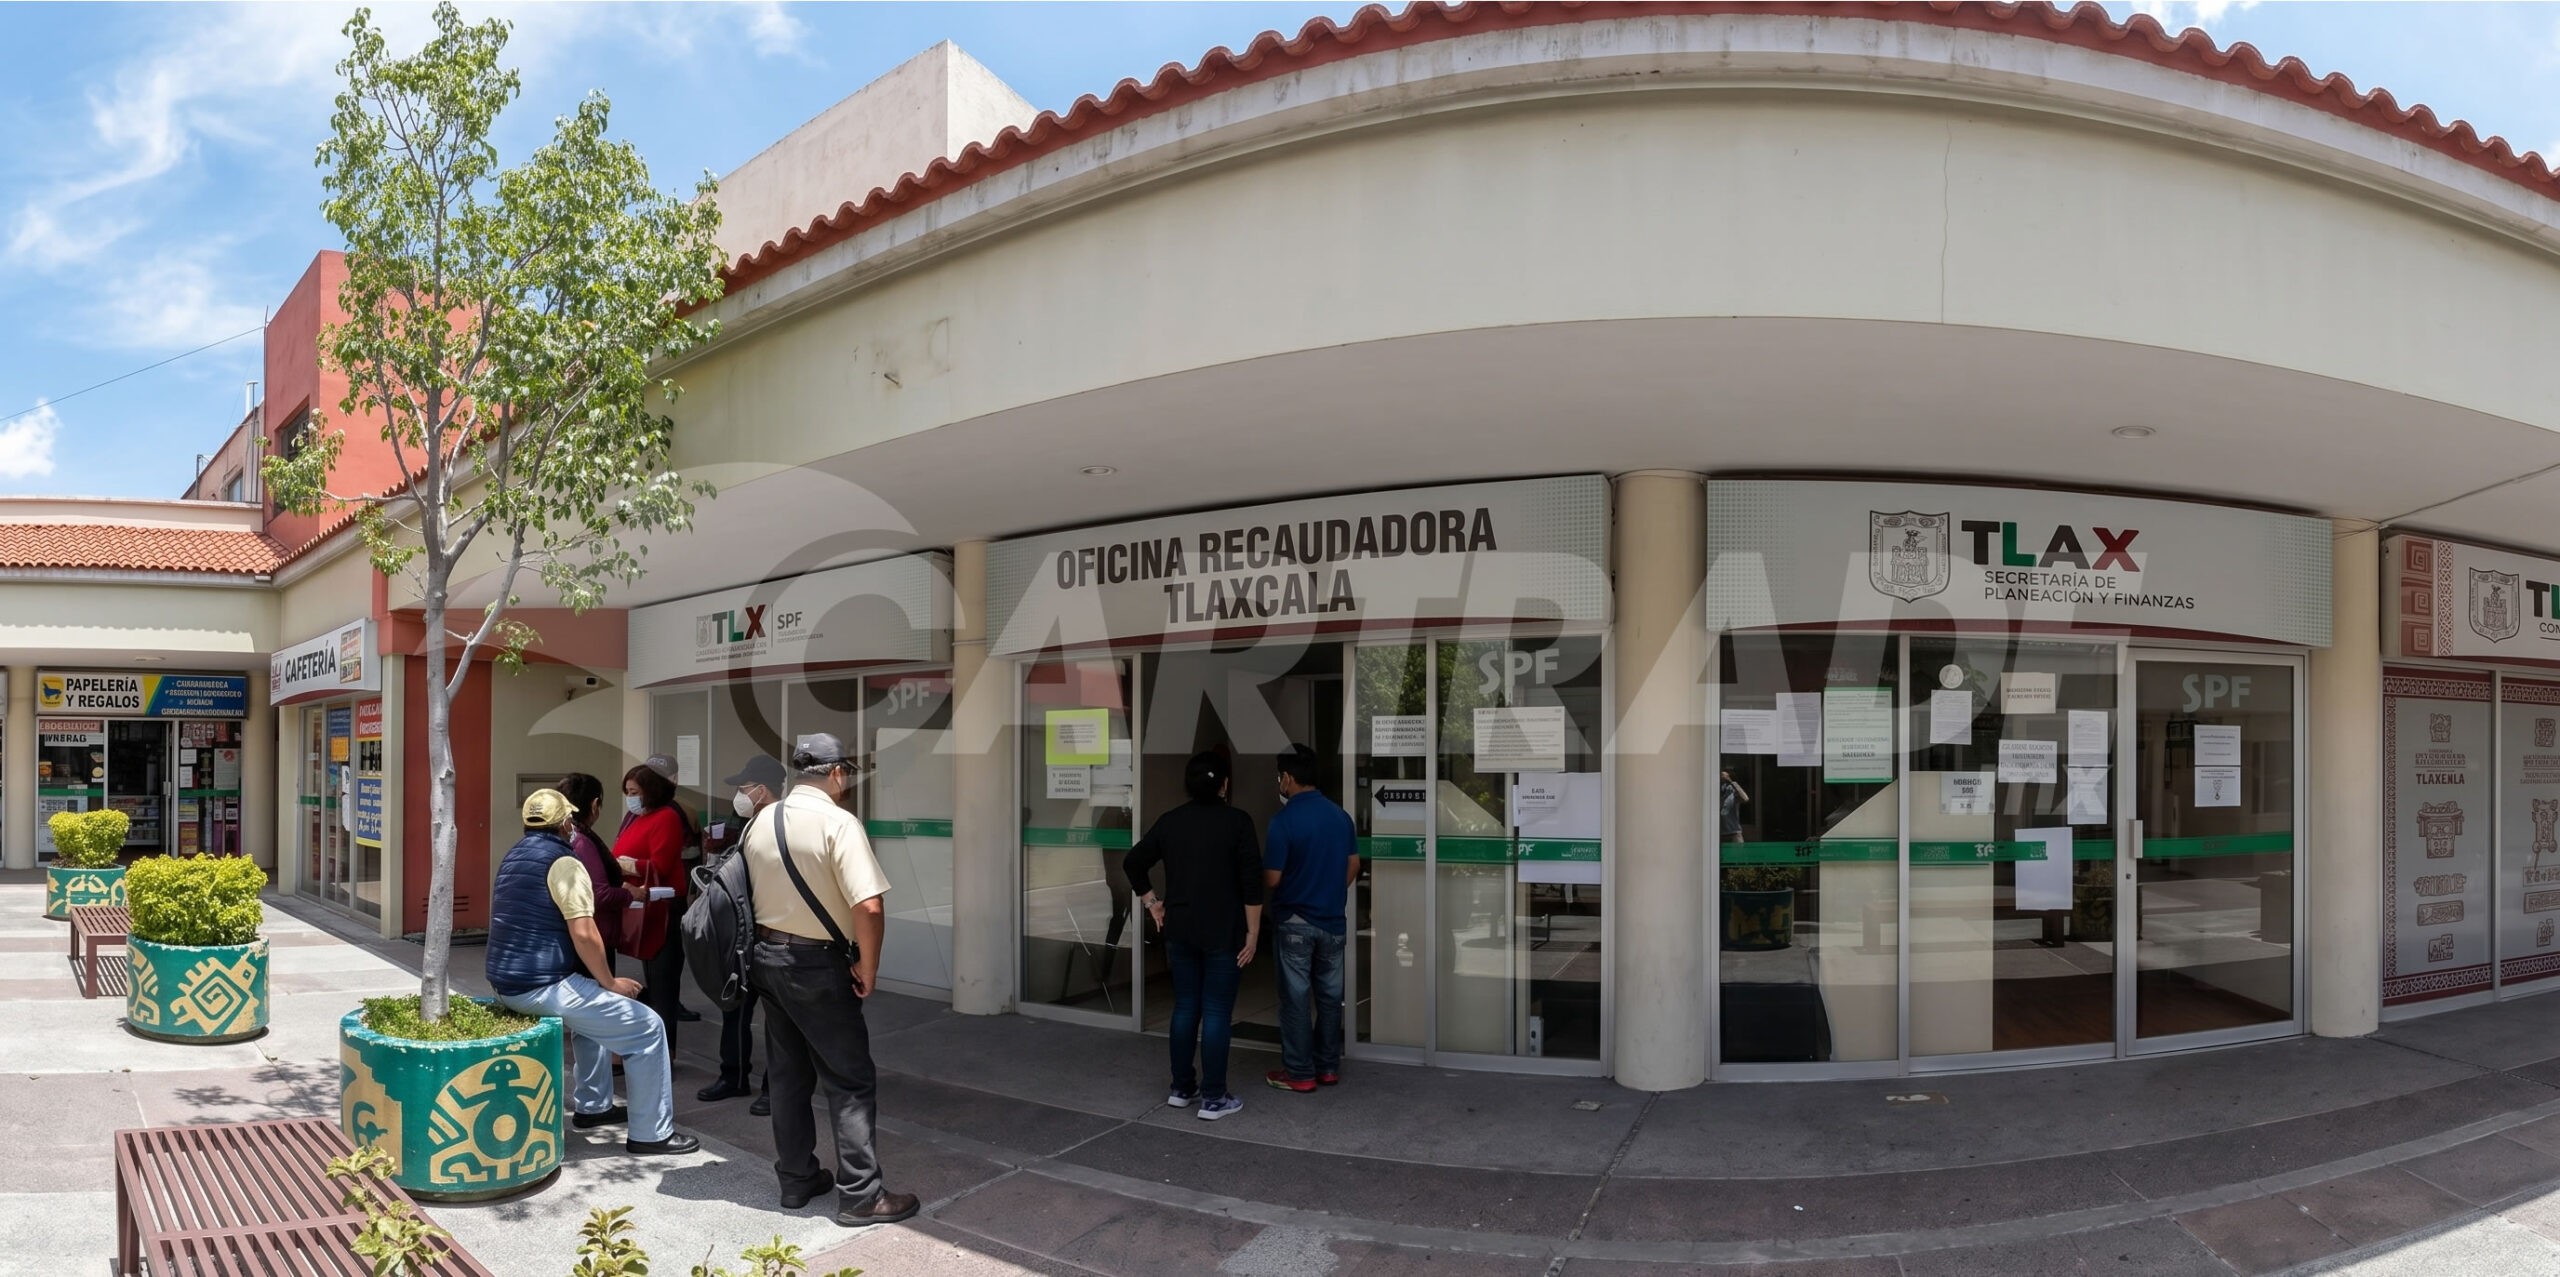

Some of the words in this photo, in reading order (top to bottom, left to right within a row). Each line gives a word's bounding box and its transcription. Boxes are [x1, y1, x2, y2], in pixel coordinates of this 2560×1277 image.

[1057, 537, 1187, 590] OFICINA
[1200, 508, 1497, 574] RECAUDADORA
[1961, 520, 2140, 573] TLAX
[1164, 568, 1356, 624] TLAXCALA
[1984, 570, 2089, 588] SECRETARÍA
[2095, 576, 2116, 589] DE
[1984, 587, 2094, 604] PLANEACIÓN
[2099, 592, 2109, 605] Y
[2114, 593, 2195, 609] FINANZAS
[712, 604, 766, 644] TLX
[777, 611, 803, 630] SPF
[285, 640, 336, 683] CAFETERÍA
[1478, 648, 1560, 694] SPF
[66, 676, 138, 692] PAPELERÍA
[66, 695, 74, 708] Y
[78, 695, 139, 709] REGALOS
[887, 680, 931, 716] SPF
[2182, 674, 2252, 713] SPF
